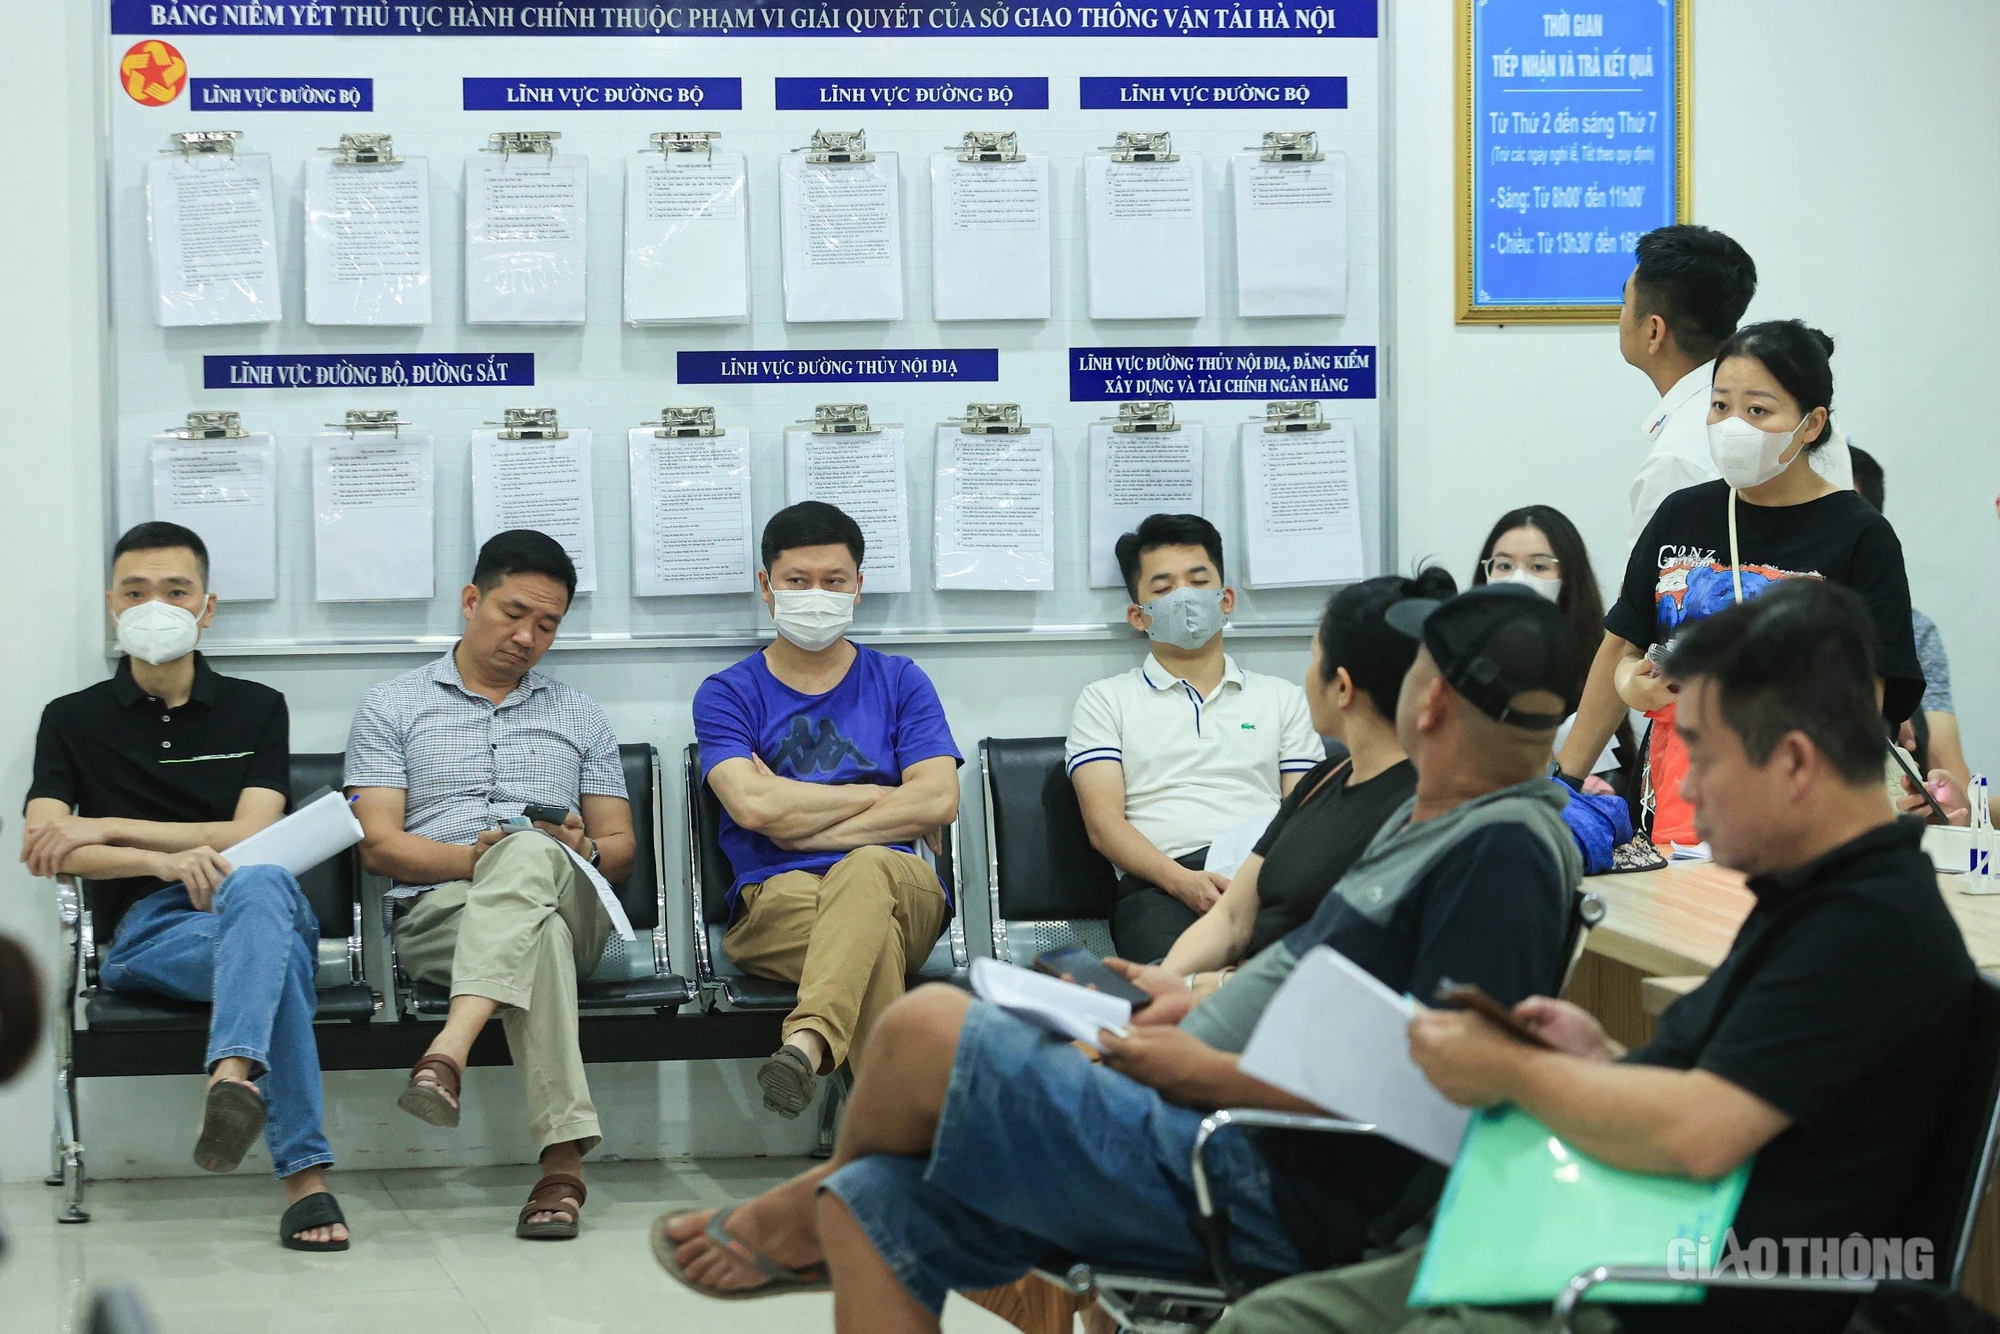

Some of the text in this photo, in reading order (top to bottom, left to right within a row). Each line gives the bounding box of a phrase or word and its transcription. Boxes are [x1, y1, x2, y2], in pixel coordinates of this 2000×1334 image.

[395, 8, 443, 33] TỤC
[449, 1, 515, 27] HÀNH
[520, 2, 596, 28] CHÍNH
[601, 5, 682, 34] THUỘC
[688, 8, 754, 34] PHẠM
[760, 8, 785, 28] VI
[790, 3, 840, 28] GIẢI
[845, 3, 923, 33] QUYẾT
[928, 2, 976, 28] CỦA
[980, 0, 1009, 28] SỞ
[1014, 7, 1072, 28] GIAO
[1078, 1, 1158, 28] THÔNG
[1163, 6, 1210, 34] VẬN
[1214, 3, 1252, 29] TẢI
[1257, 2, 1290, 28] HÀ
[1294, 6, 1336, 35] NỘI
[1543, 8, 1603, 37] THỜI GIAN
[1492, 46, 1654, 83] TIẾP NHẬN VÀ TRẢ KẾT QUẢ
[203, 84, 361, 108] LĨNH VỰC ĐƯỜNG BỘ
[506, 83, 704, 107] LĨNH VỰC ĐƯỜNG BỘ
[819, 84, 1013, 107] LĨNH VỰC ĐƯỜNG BỘ
[1120, 83, 1310, 106] LĨNH VỰC ĐƯỜNG BỘ
[1489, 106, 1657, 139] Từ Thứ 2 đến sáng Thứ 7
[1585, 181, 1606, 208] đến
[1595, 226, 1617, 254] đến
[230, 354, 508, 388] LĨNH VỰC ĐƯỜNG BỘ, ĐƯỜNG SẮT
[721, 357, 758, 376] LĨNH
[762, 360, 794, 379] VỰC
[798, 357, 853, 375] ĐƯỜNG
[856, 356, 898, 374] THỦY
[901, 357, 928, 378] NỘI
[1079, 354, 1113, 371] LĨNH
[1116, 355, 1143, 374] VỰC
[1146, 353, 1194, 371] ĐƯỜNG
[1197, 352, 1234, 370] THỦY
[1237, 353, 1261, 373] NỘI
[1293, 353, 1331, 369] ĐĂNG
[1334, 348, 1370, 369] KIỂM
[1105, 374, 1349, 396] XÂY DỰNG VÀ TÀI CHÍNH NGÂN HÀNG
